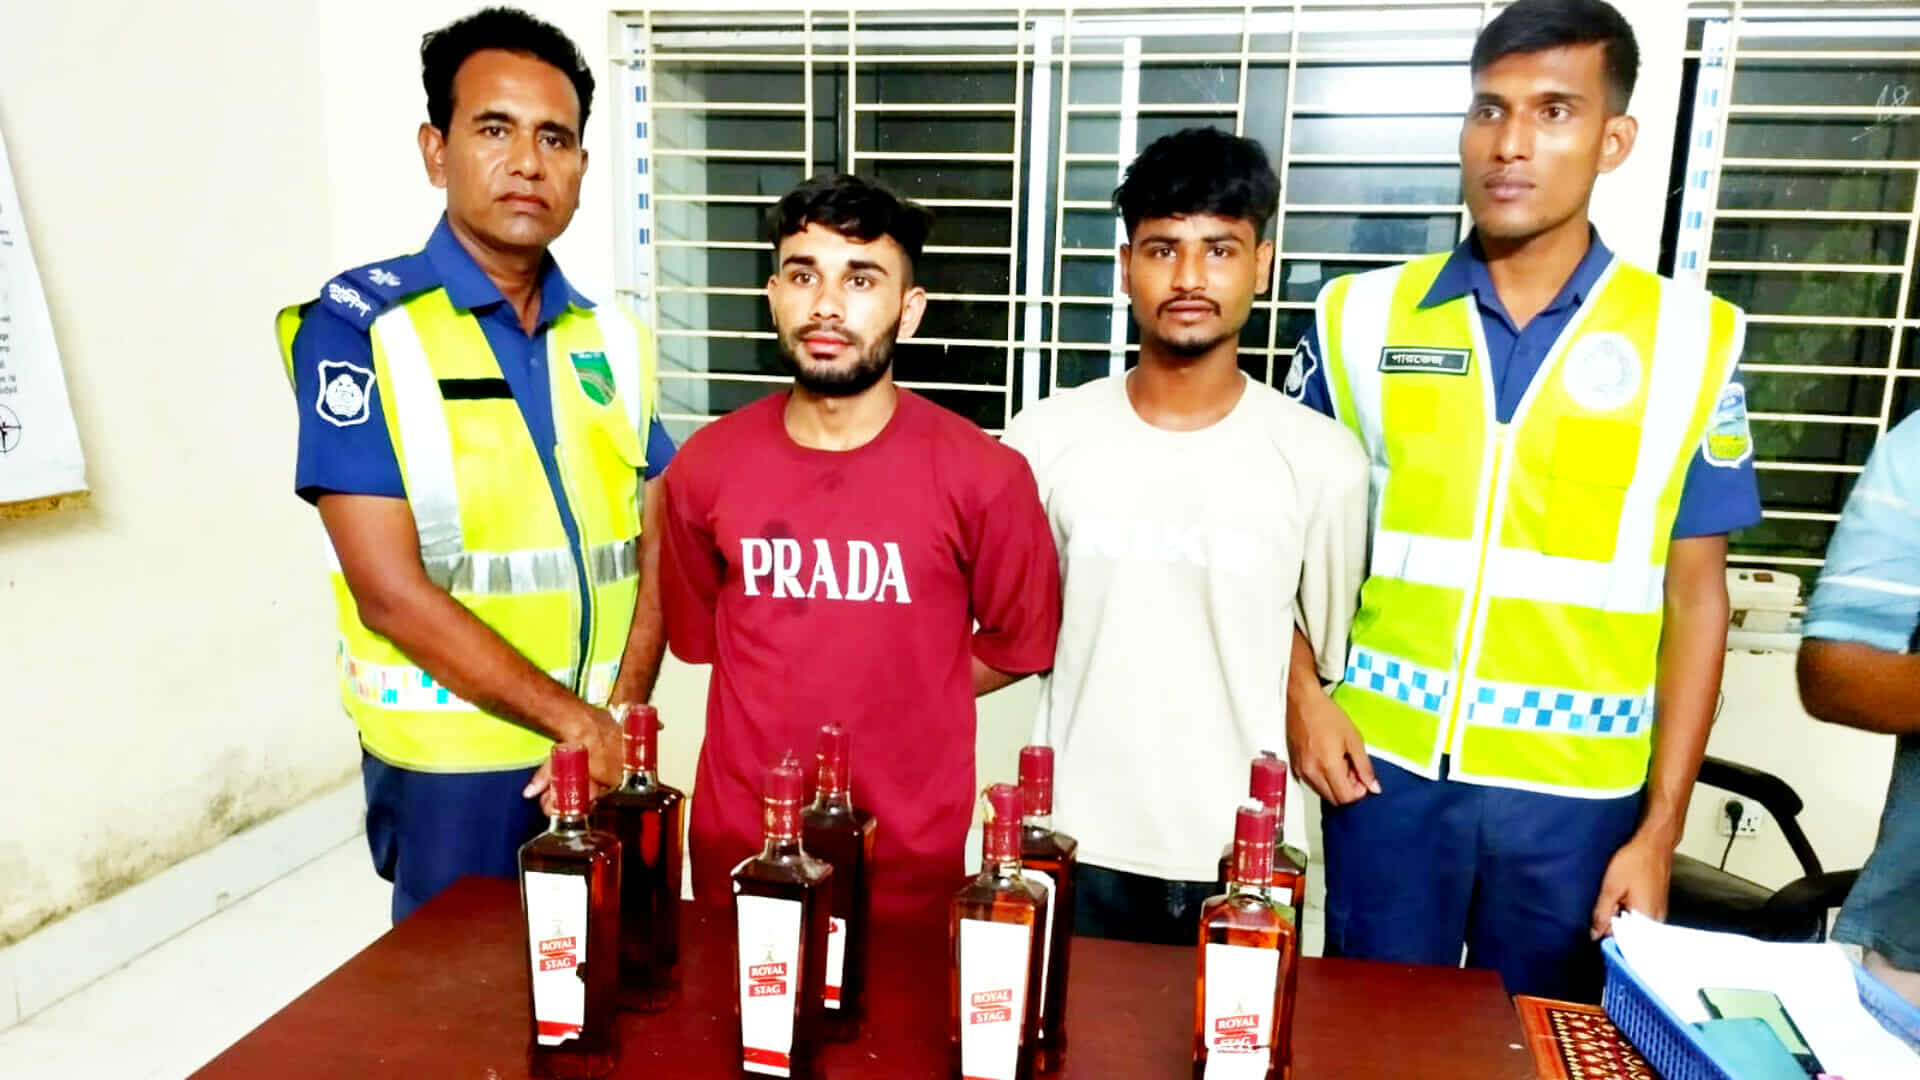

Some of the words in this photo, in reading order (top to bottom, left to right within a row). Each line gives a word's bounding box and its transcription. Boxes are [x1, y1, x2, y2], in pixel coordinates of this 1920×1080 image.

[740, 538, 912, 604] PRADA
[542, 938, 574, 953] ROYAL
[545, 957, 572, 970] STAG
[751, 965, 785, 977] ROYAL
[753, 984, 781, 994] STAG
[974, 991, 1009, 1003] ROYAL
[976, 1010, 1006, 1023] STAG
[1218, 1016, 1256, 1029] ROYAL
